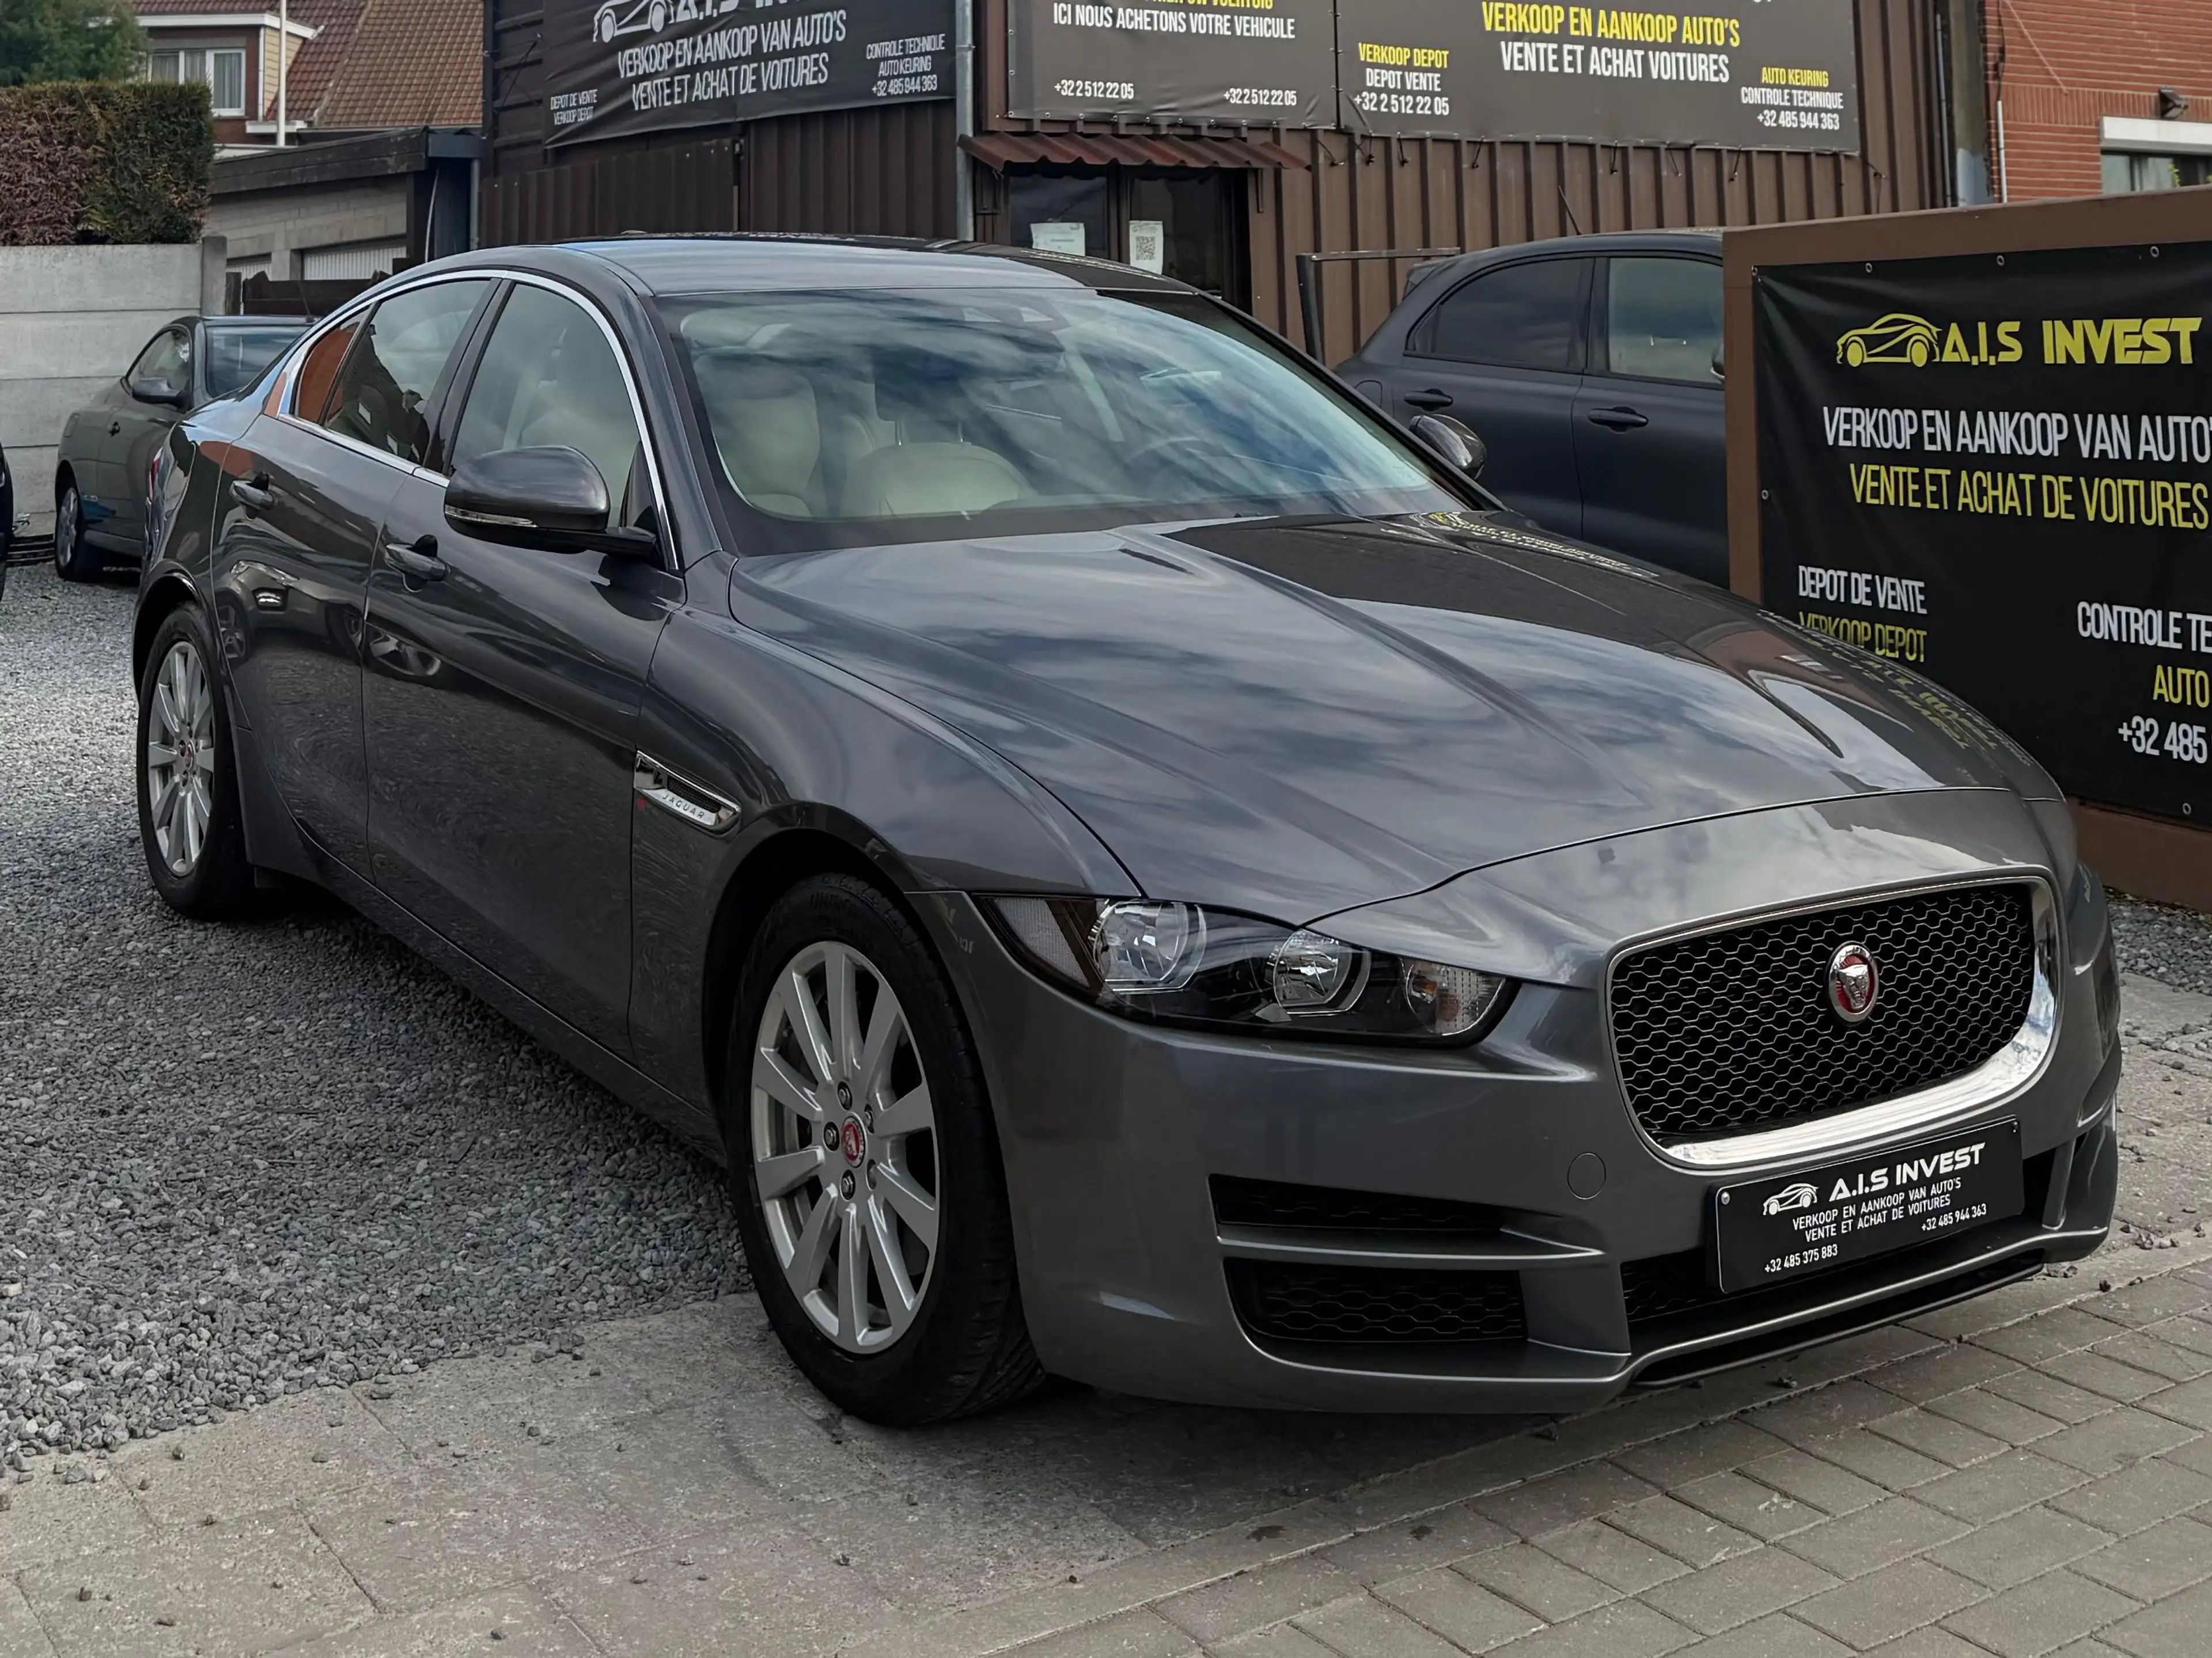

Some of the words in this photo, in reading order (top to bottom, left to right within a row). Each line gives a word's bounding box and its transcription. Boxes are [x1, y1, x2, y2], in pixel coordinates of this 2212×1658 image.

[1054, 3, 1071, 24] ICI
[1075, 5, 1112, 28] NOUS
[1116, 8, 1187, 33] ACHETONS
[1189, 13, 1231, 35] VOTRE
[1234, 16, 1296, 39] VEHICULE
[1482, 1, 1565, 34] VERKOOP
[1569, 6, 1592, 37] EN
[1597, 9, 1677, 43] AANKOOP
[1681, 16, 1740, 47] AUTO'S
[619, 41, 673, 78] VERKOOP
[675, 37, 692, 68] EN
[694, 25, 757, 65] AANKOOP
[760, 18, 791, 52] VAN
[793, 9, 846, 48] AUTO'S
[866, 40, 903, 59] CONTROLE
[905, 33, 945, 54] TECHNIQUE
[1358, 42, 1411, 66] VERKOOP
[1413, 48, 1449, 69] DEPOT
[878, 60, 899, 77] AUTO
[900, 55, 931, 74] KEURING
[1366, 67, 1403, 89] DEPOT
[1404, 71, 1441, 92] VENTE
[1501, 41, 1559, 73] VENTE
[1562, 44, 1585, 74] ET
[1589, 46, 1645, 79] ACHAT
[1648, 50, 1729, 84] VOITURES
[1762, 66, 1786, 85] AUTO
[1787, 69, 1829, 88] KEURING
[632, 77, 671, 111] VENTE
[674, 74, 691, 104] ET
[692, 65, 738, 102] ACHAT
[740, 63, 757, 94] DE
[761, 52, 829, 91] VOITURES
[872, 80, 887, 96] +32
[888, 78, 903, 95] 485
[904, 76, 921, 93] 944
[922, 74, 937, 92] 363
[1054, 79, 1074, 96] +32
[1076, 80, 1083, 96] 2
[1085, 81, 1104, 97] 512
[1106, 82, 1119, 98] 22
[1120, 82, 1134, 99] 05
[1223, 88, 1243, 104] +32
[1244, 88, 1251, 104] 2
[1251, 89, 1270, 105] 512
[1271, 89, 1284, 105] 22
[1285, 90, 1297, 106] 05
[1741, 86, 1791, 106] CONTROLE
[1791, 89, 1843, 109] TECHNIQUE
[1354, 91, 1378, 111] +32
[1380, 93, 1388, 112] 2
[1391, 94, 1414, 113] 512
[1416, 95, 1431, 115] 22
[1434, 96, 1449, 116] 05
[1757, 109, 1777, 127] +32
[1778, 111, 1798, 128] 485
[1800, 112, 1819, 128] 944
[1820, 113, 1839, 130] 363
[1941, 320, 2022, 366] A.I.S
[2042, 317, 2202, 364] INVEST
[1823, 406, 1918, 449] VERKOOP
[1922, 409, 1951, 452] EN
[1956, 410, 2068, 457] AANKOOP
[2073, 413, 2131, 460] VAN
[1850, 463, 1920, 508] VENTE
[1924, 468, 1951, 510] ET
[1957, 470, 2036, 516] ACHAT
[2041, 475, 2075, 519] DE
[2080, 477, 2209, 529] VOITURES
[1798, 565, 1848, 602] DEPOT
[1851, 572, 1872, 606] DE
[1875, 575, 1927, 614] VENTE
[1875, 623, 1927, 662] DEPOT
[2077, 601, 2183, 649] CONTROLE
[2153, 665, 2210, 708] AUTO
[2118, 715, 2160, 756] +32
[2164, 722, 2207, 764] 485
[662, 795, 705, 819] JAGUAR
[1896, 1142, 1986, 1185] INVEST
[1793, 1209, 1838, 1231] VERKOOP
[1843, 1203, 1855, 1219] EN
[1860, 1192, 1905, 1213] AANKOOP
[1908, 1186, 1926, 1201] VAN
[1930, 1177, 1961, 1196] AUTO'S
[1805, 1223, 1836, 1242] VENTE
[1841, 1217, 1853, 1234] ET
[1857, 1210, 1887, 1230] ACHAT
[1892, 1206, 1904, 1221] DE
[1908, 1194, 1950, 1216] VOITURES
[1921, 1217, 1937, 1231] +32
[1938, 1212, 1953, 1227] 485
[1955, 1208, 1970, 1222] 944
[1971, 1203, 1986, 1218] 363
[1764, 1258, 1782, 1272] +32
[1784, 1253, 1801, 1268] 485
[1802, 1248, 1819, 1264] 375
[1821, 1244, 1838, 1258] 883
